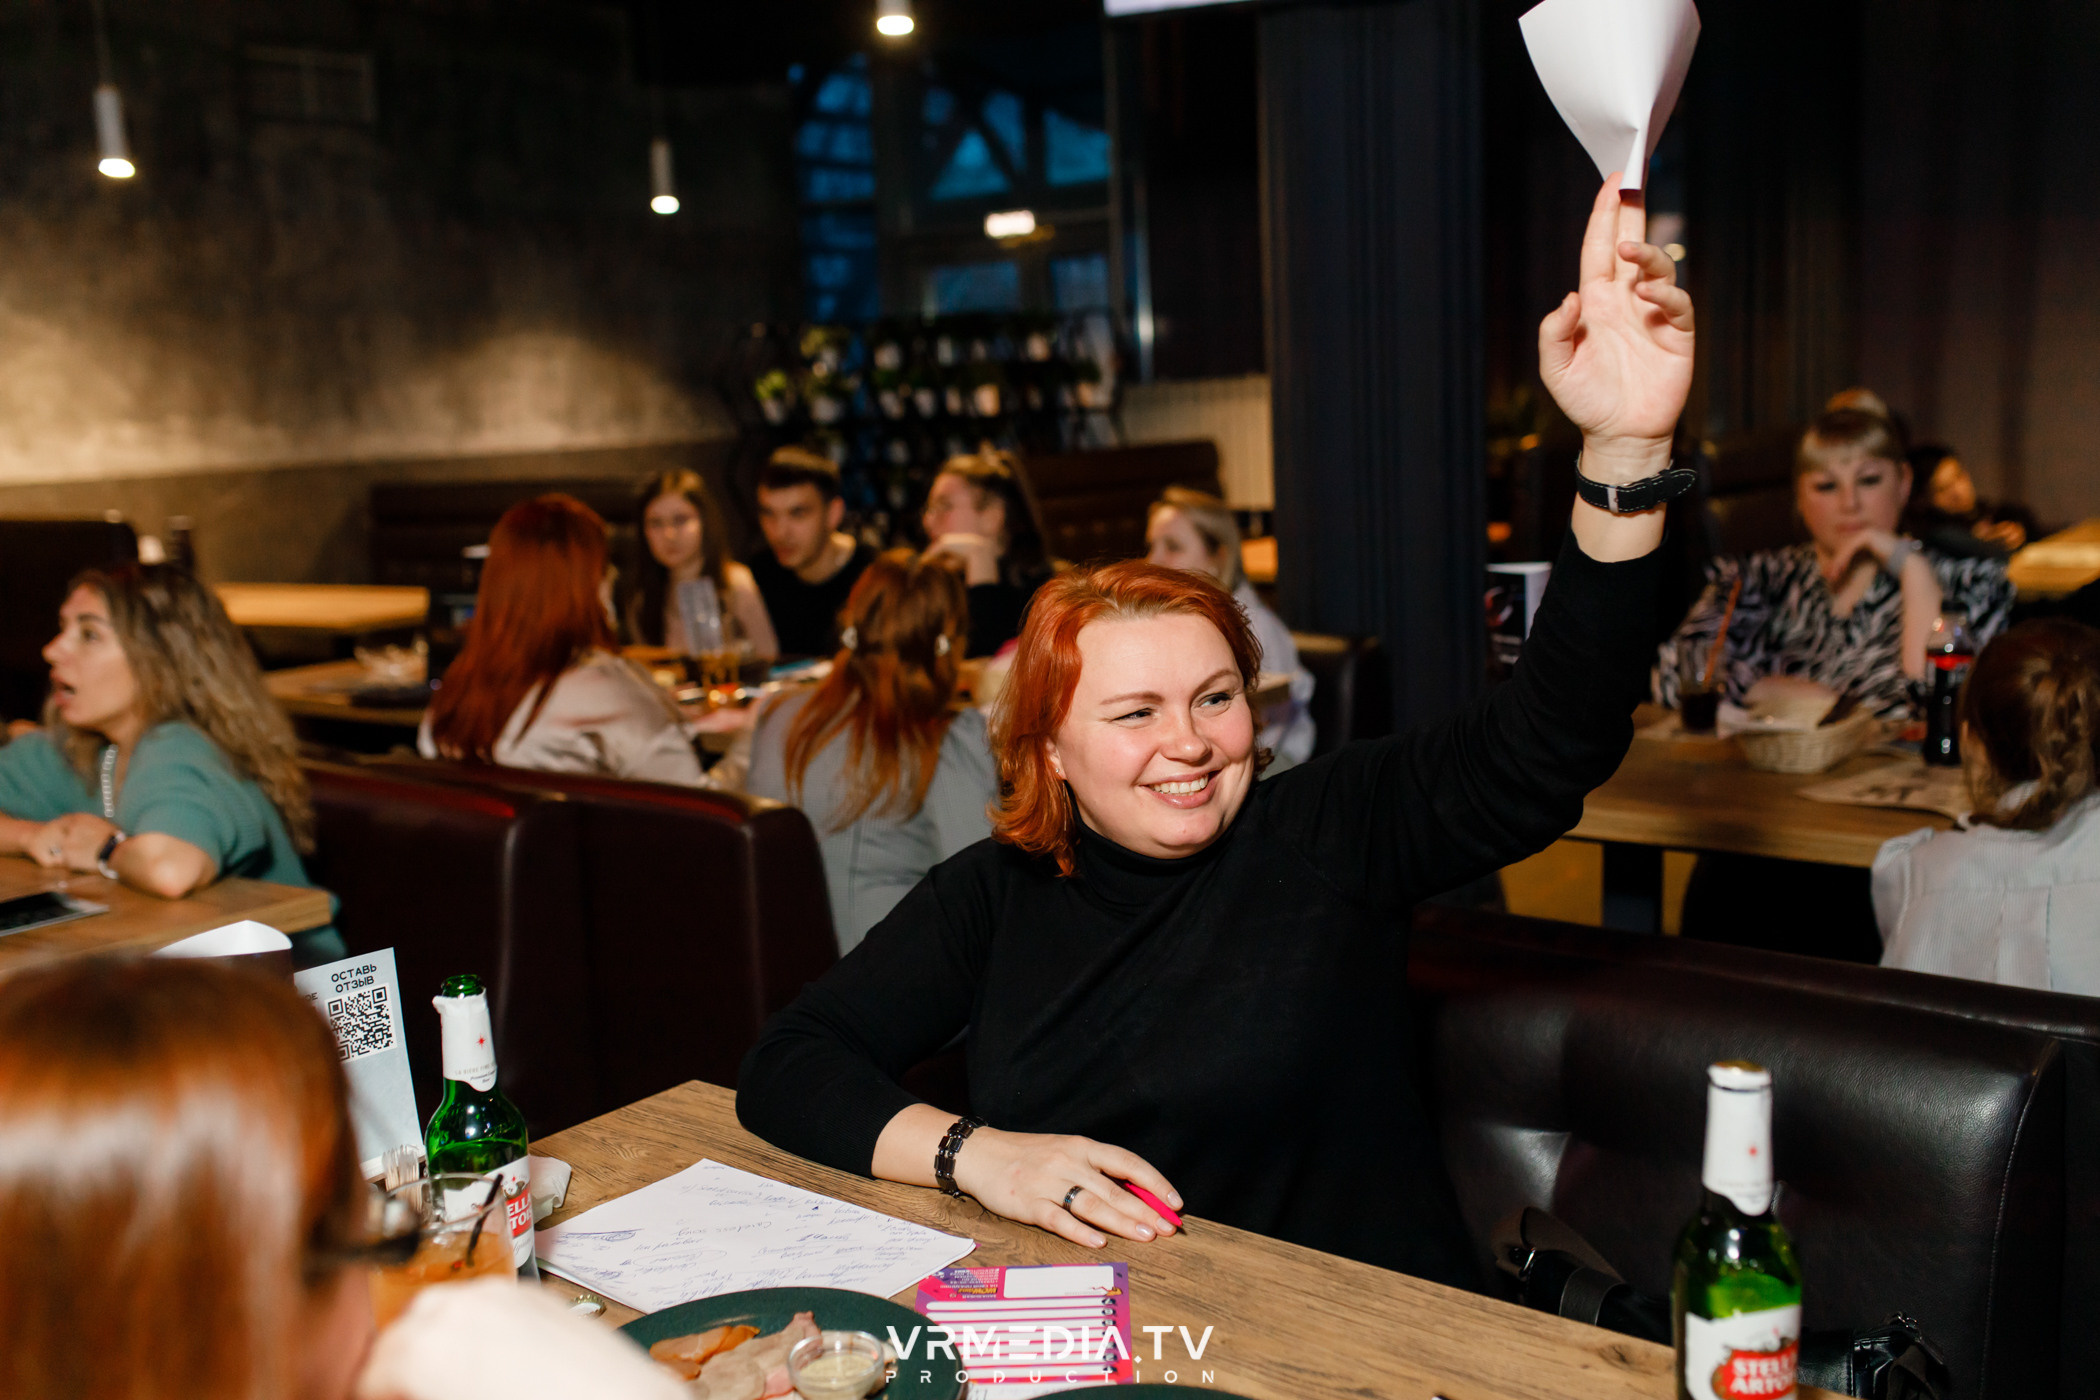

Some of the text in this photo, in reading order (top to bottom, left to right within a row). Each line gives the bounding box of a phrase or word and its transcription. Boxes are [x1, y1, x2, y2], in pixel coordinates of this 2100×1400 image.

[331, 964, 377, 982] ОСТАВЬ
[335, 975, 375, 993] ОТЗЫВ
[506, 1193, 532, 1217] ELLA
[1730, 1371, 1794, 1395] ARTO
